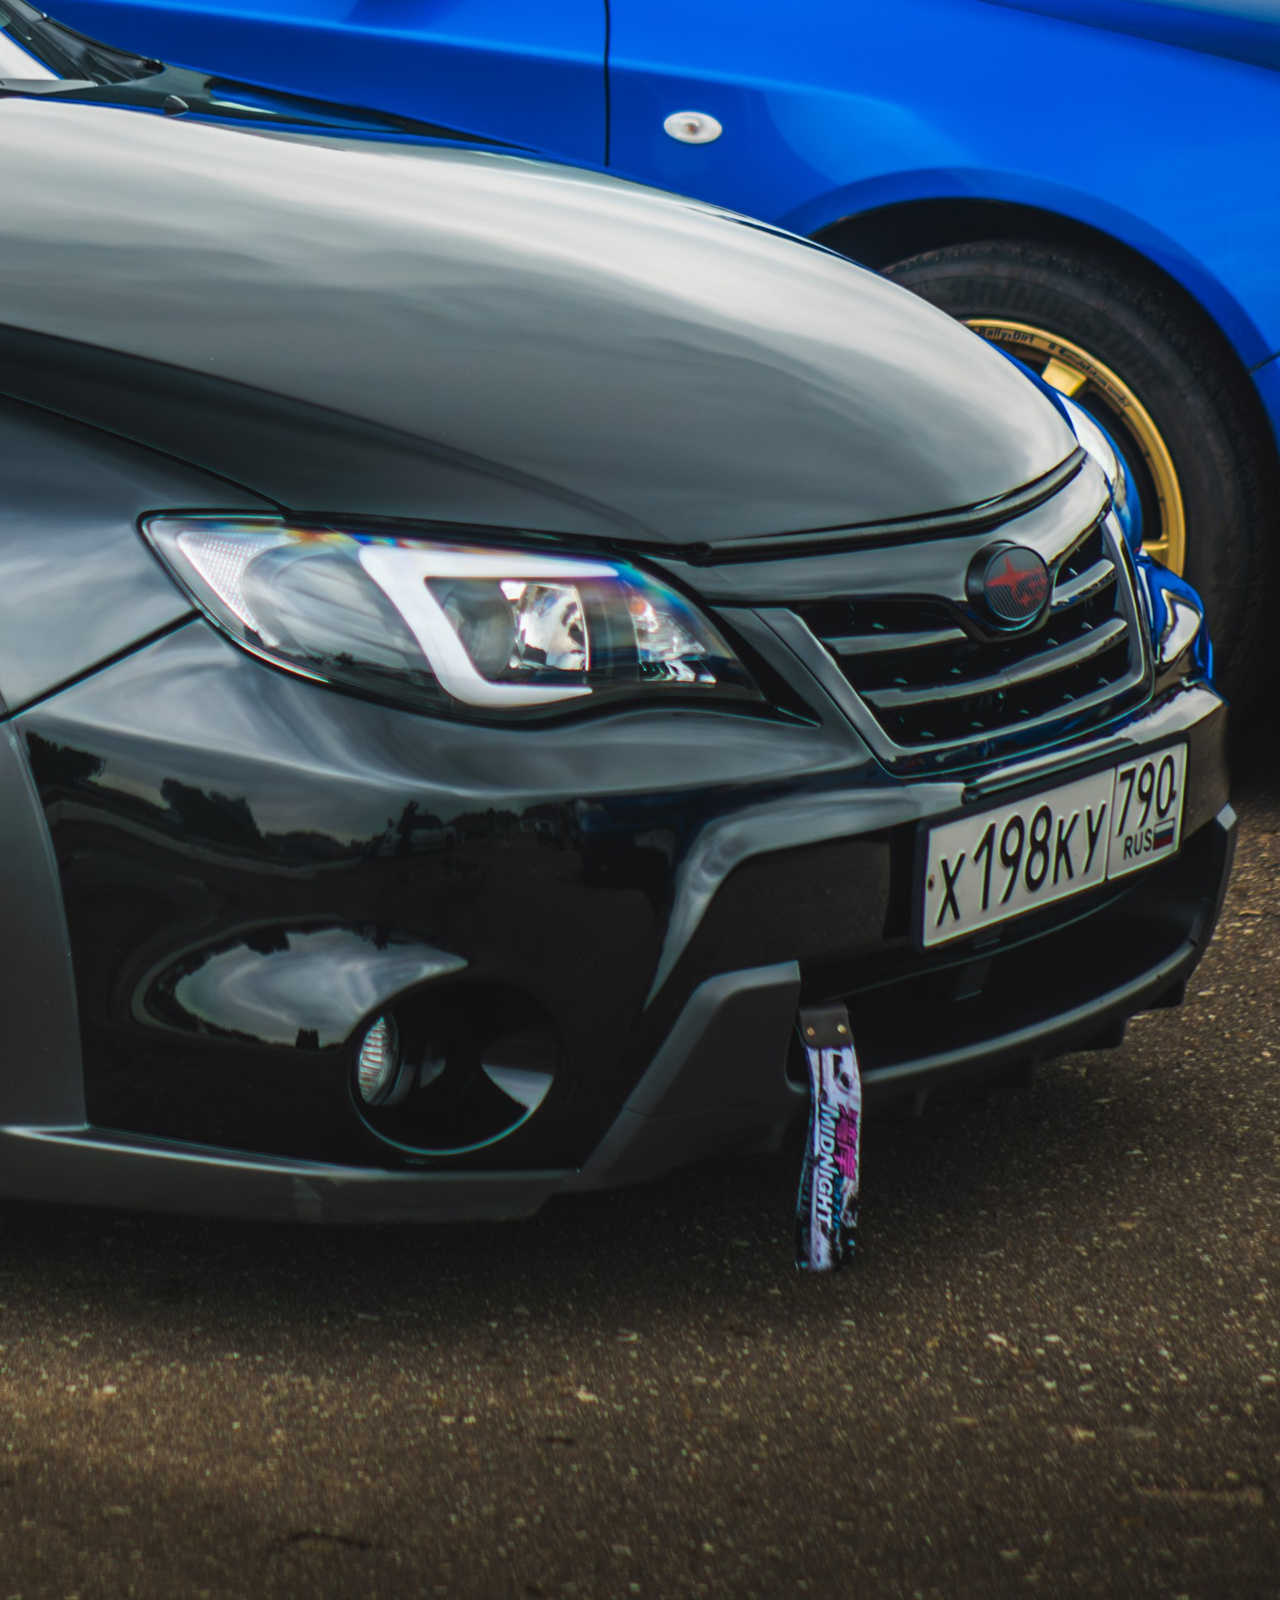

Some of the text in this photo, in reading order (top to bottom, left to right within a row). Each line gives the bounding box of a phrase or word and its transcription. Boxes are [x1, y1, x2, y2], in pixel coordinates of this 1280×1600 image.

[1116, 753, 1175, 838] 790
[1123, 828, 1153, 861] RUS
[816, 1102, 840, 1231] MIDNIGHT
